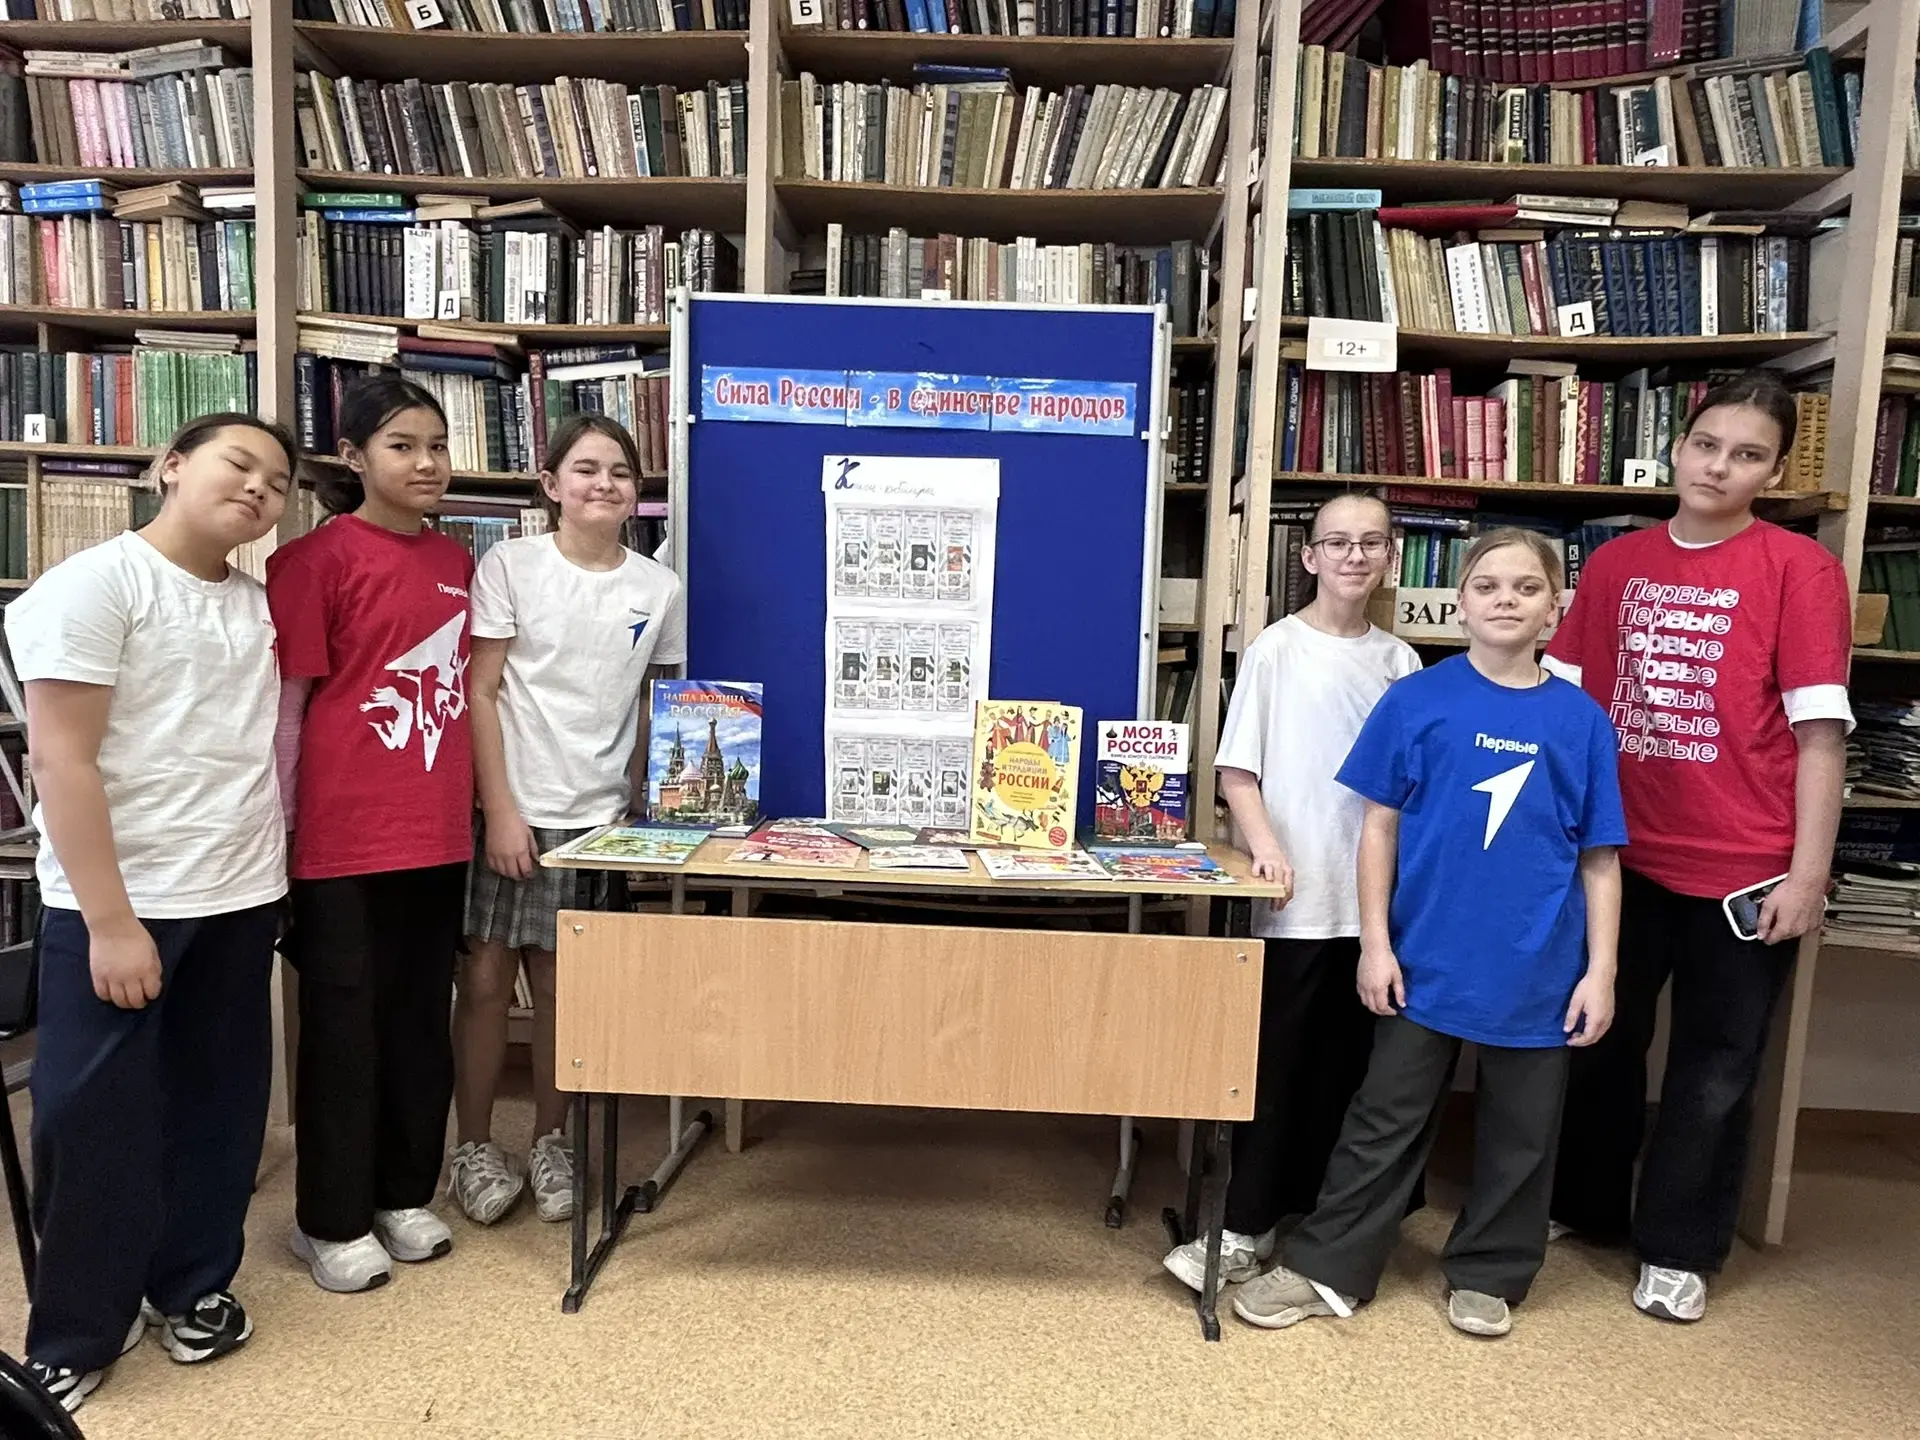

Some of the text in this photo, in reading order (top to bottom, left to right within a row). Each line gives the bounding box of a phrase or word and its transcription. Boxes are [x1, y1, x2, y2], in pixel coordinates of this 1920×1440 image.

[416, 4, 432, 21] Б
[800, 0, 813, 17] Б
[443, 297, 455, 315] Д
[1570, 312, 1585, 332] Д
[1336, 341, 1367, 356] 12+
[715, 377, 770, 408] Сила
[780, 378, 861, 410] России
[888, 387, 899, 409] в
[910, 387, 1020, 417] единстве
[1029, 396, 1126, 429] народов
[31, 424, 40, 437] К
[1634, 469, 1647, 483] Р
[1622, 577, 1740, 609] Первые
[1400, 602, 1457, 625] ЗАР
[1618, 601, 1732, 635] Первые
[1617, 626, 1724, 661] Первые
[1617, 651, 1717, 688] Первые
[663, 692, 746, 704] НАША РОДИНА
[670, 705, 741, 718] РОССИЯ
[1609, 701, 1720, 738] Первые
[1122, 725, 1163, 740] МОЯ
[1107, 740, 1178, 755] РОССИЯ
[1475, 732, 1539, 755] Первые
[998, 772, 1050, 790] РОССИИ
